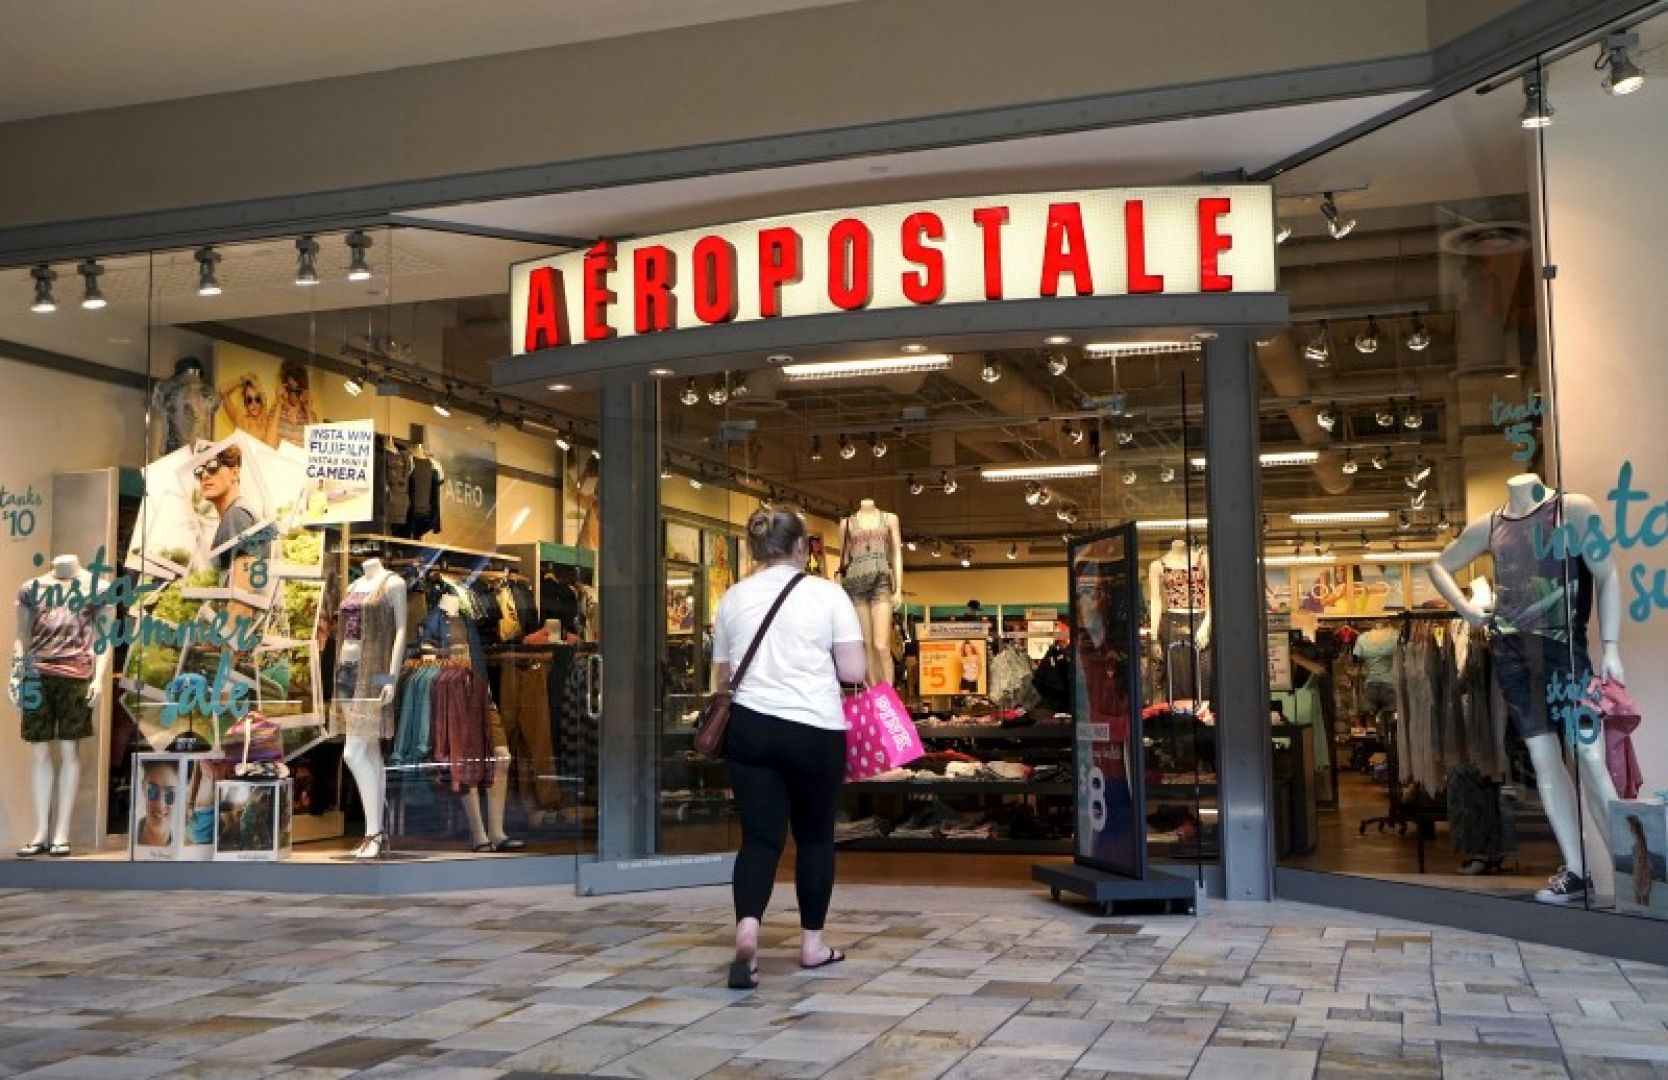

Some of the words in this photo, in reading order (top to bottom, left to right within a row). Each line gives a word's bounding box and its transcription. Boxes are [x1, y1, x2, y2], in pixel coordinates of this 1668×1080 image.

[525, 197, 1233, 353] AÉROPOSTALE
[310, 428, 343, 440] INSTA
[347, 430, 372, 440] WIN
[309, 441, 370, 457] FUJIFILM
[305, 465, 367, 482] CAMERA
